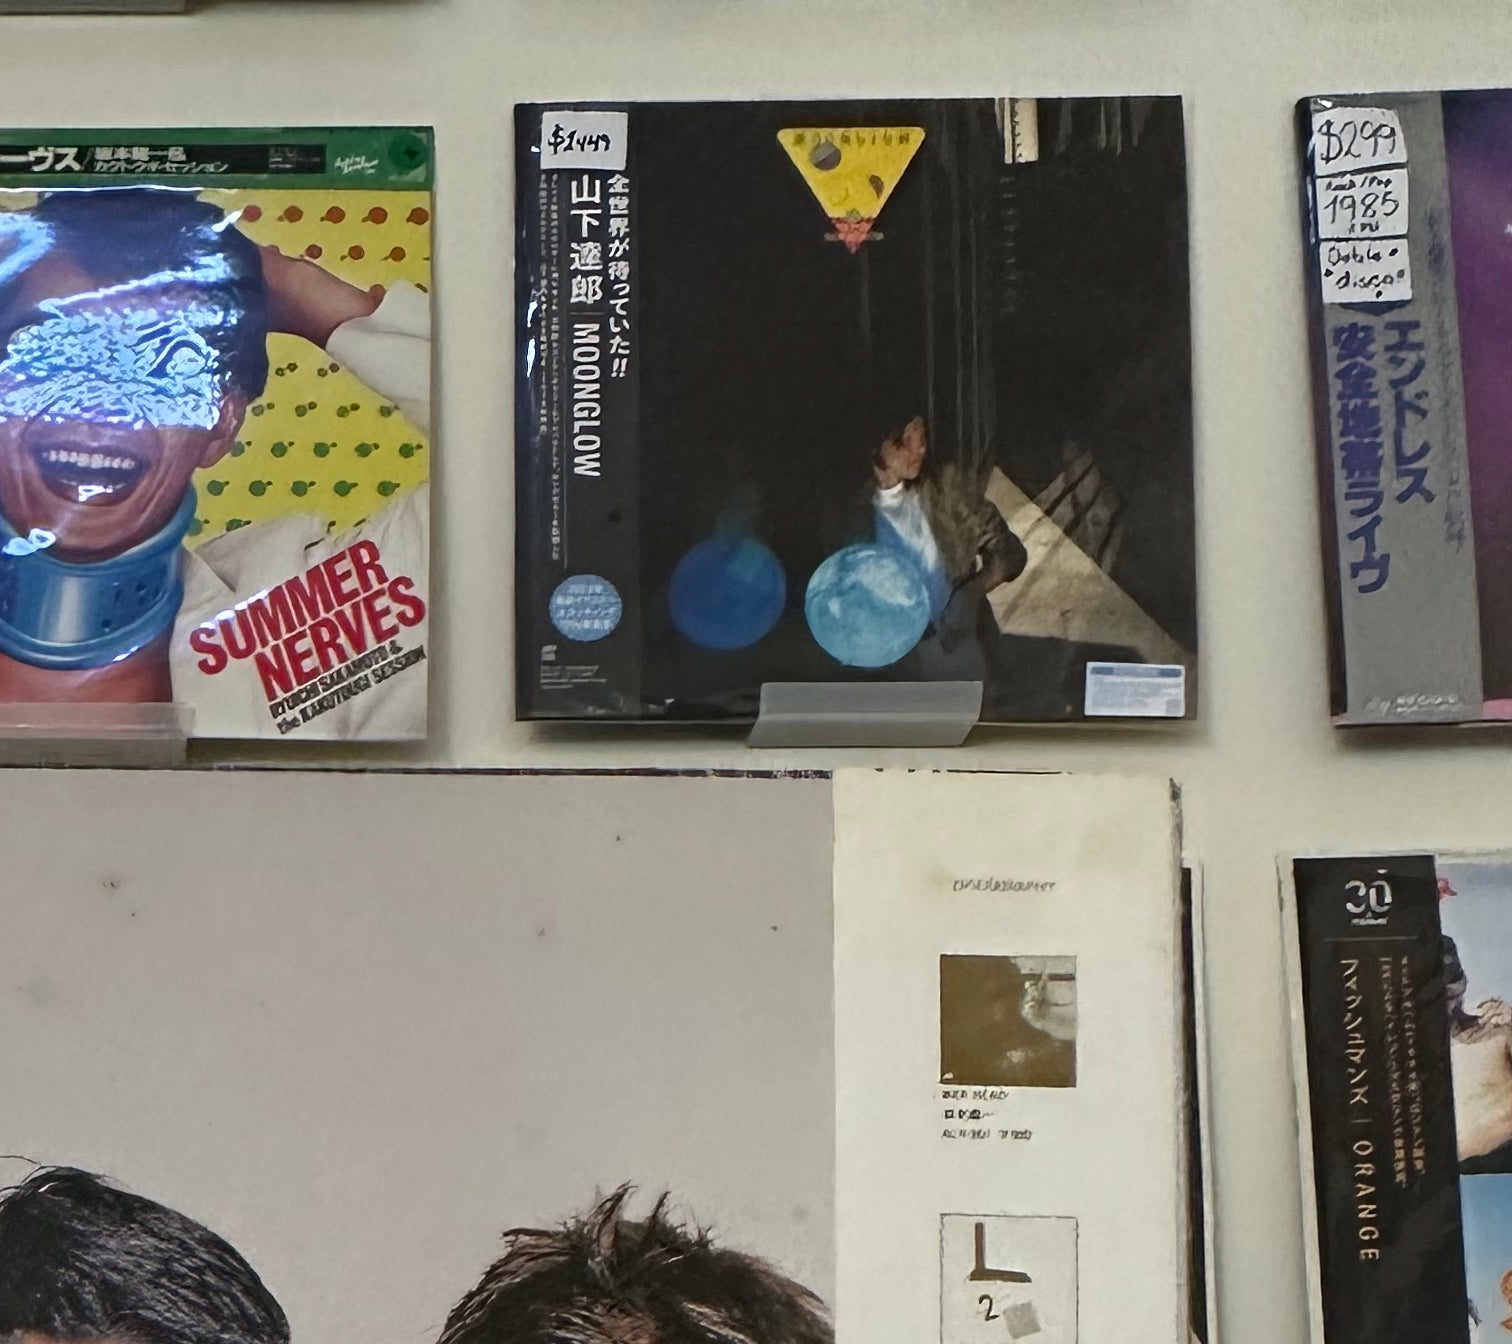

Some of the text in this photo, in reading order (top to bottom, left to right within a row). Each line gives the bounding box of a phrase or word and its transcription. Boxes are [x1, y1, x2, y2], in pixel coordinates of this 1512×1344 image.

[1317, 119, 1397, 165] $299
[1324, 191, 1400, 225] 1985
[572, 322, 601, 478] MOONGLOW
[1384, 320, 1437, 505] エンドレス
[189, 539, 389, 676] SUMMER
[254, 576, 427, 703] NERVES
[1352, 1140, 1381, 1262] ORANGE
